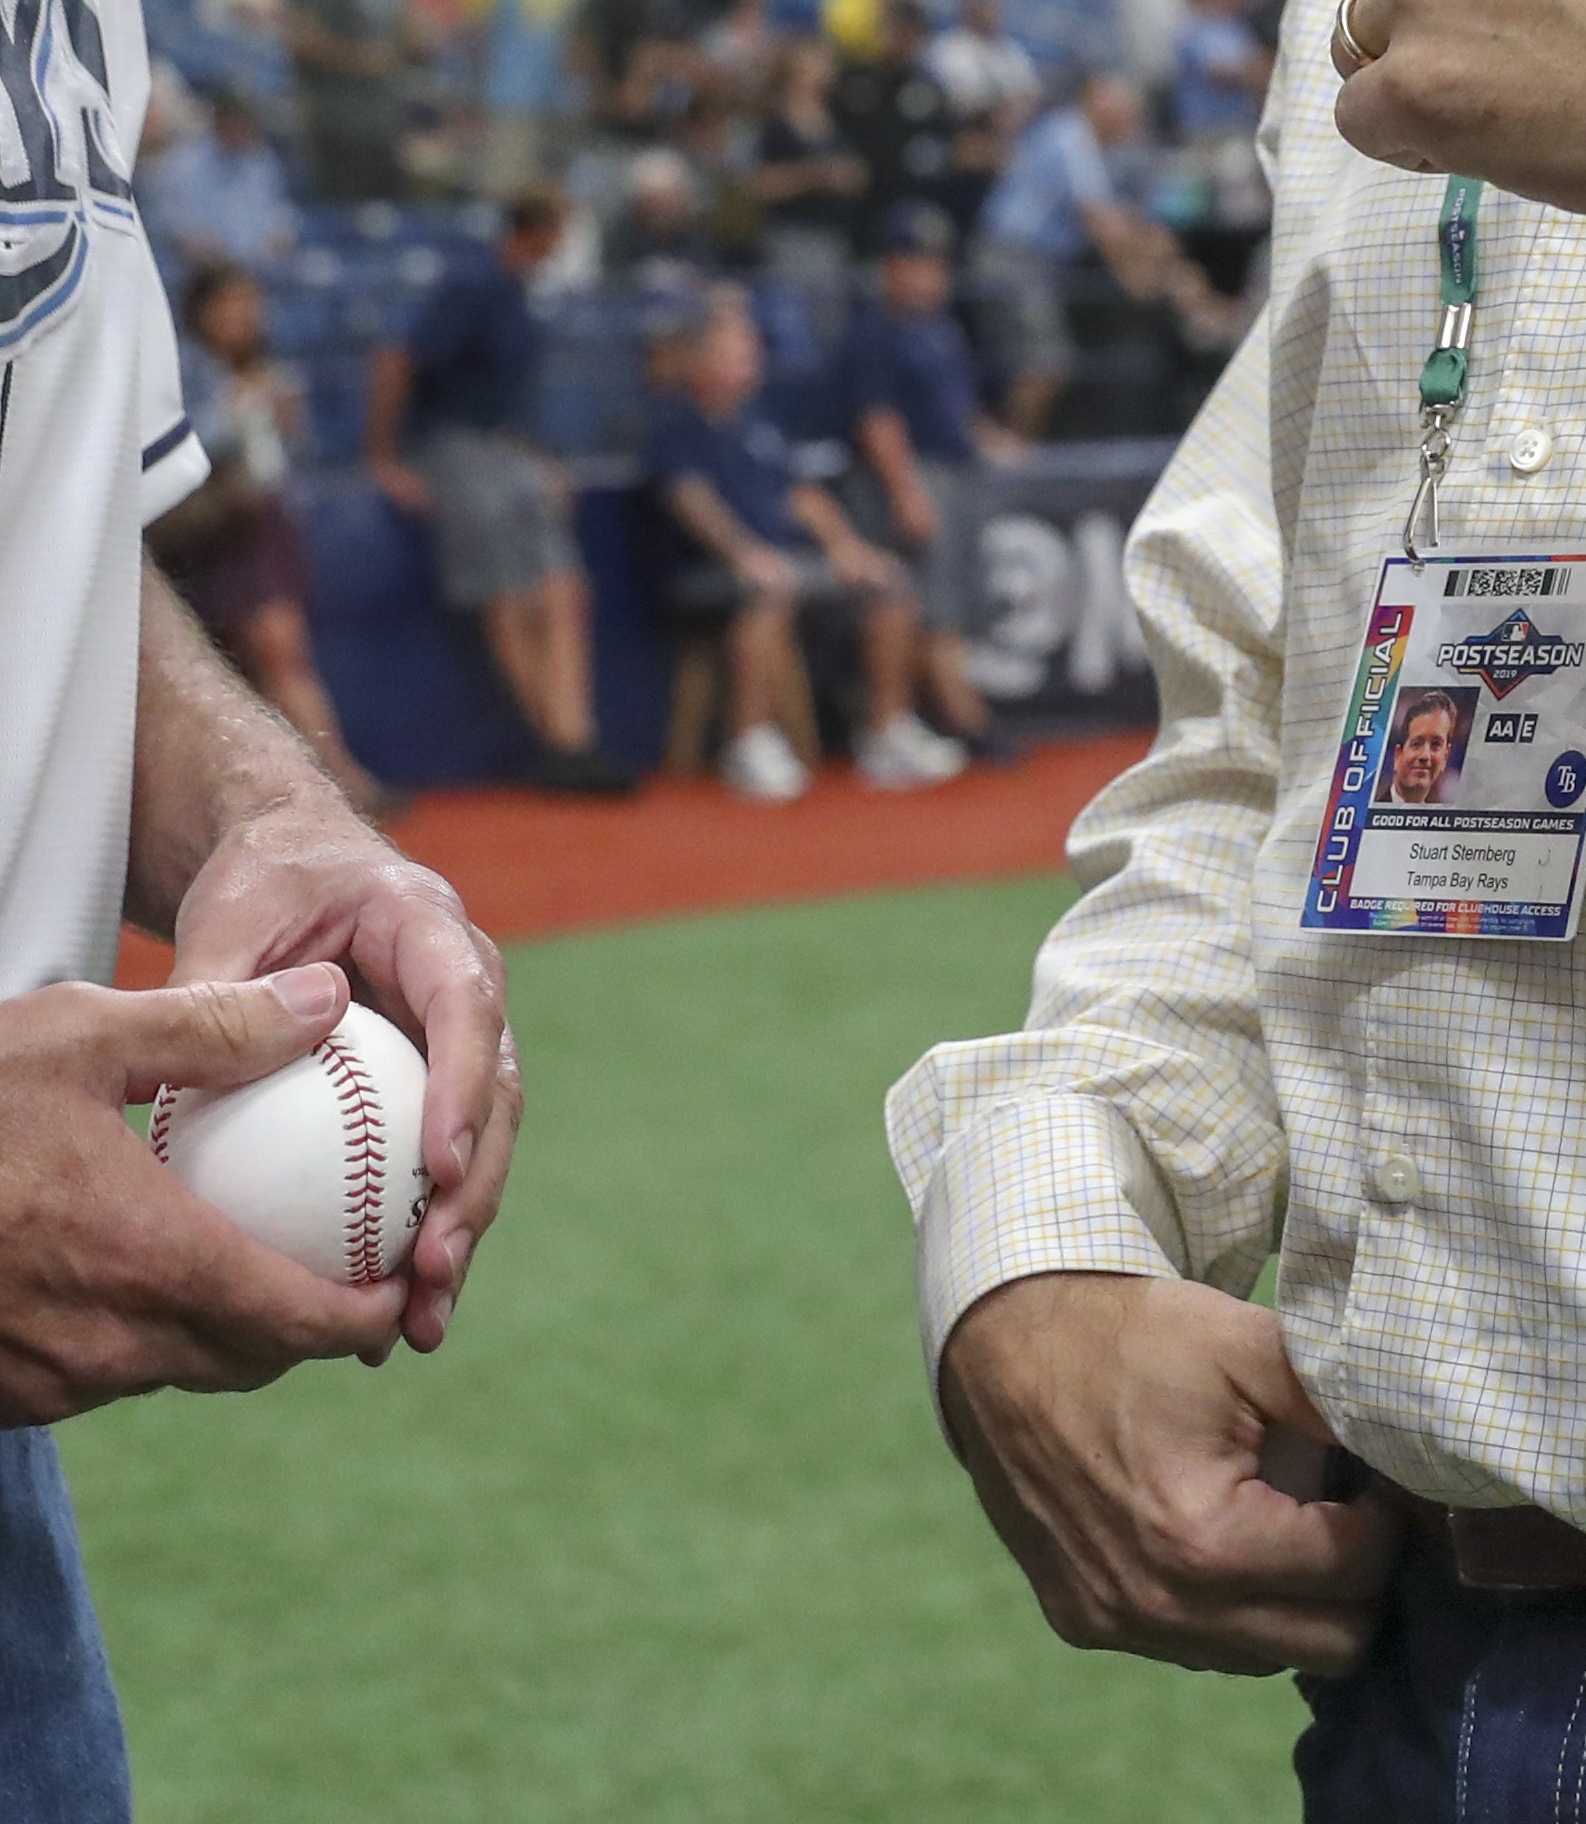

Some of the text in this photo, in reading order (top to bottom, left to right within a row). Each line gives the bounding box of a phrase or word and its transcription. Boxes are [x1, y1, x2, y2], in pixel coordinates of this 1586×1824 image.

[1437, 643, 1585, 667] POSTSEASON
[1492, 669, 1518, 680] 2019
[1488, 720, 1536, 738] AA E
[1316, 611, 1404, 914] CLUB OFFICIAL
[1557, 764, 1578, 794] TB
[1371, 814, 1576, 831] GOOD FOR ALL POSTSEASON GAMES
[1409, 843, 1517, 865] Stuart Sternberg
[1407, 871, 1509, 891] Tampa Bay Rays
[1349, 899, 1562, 917] BADGE REQUIRED FOR CLUBHOUSE ACCESS
